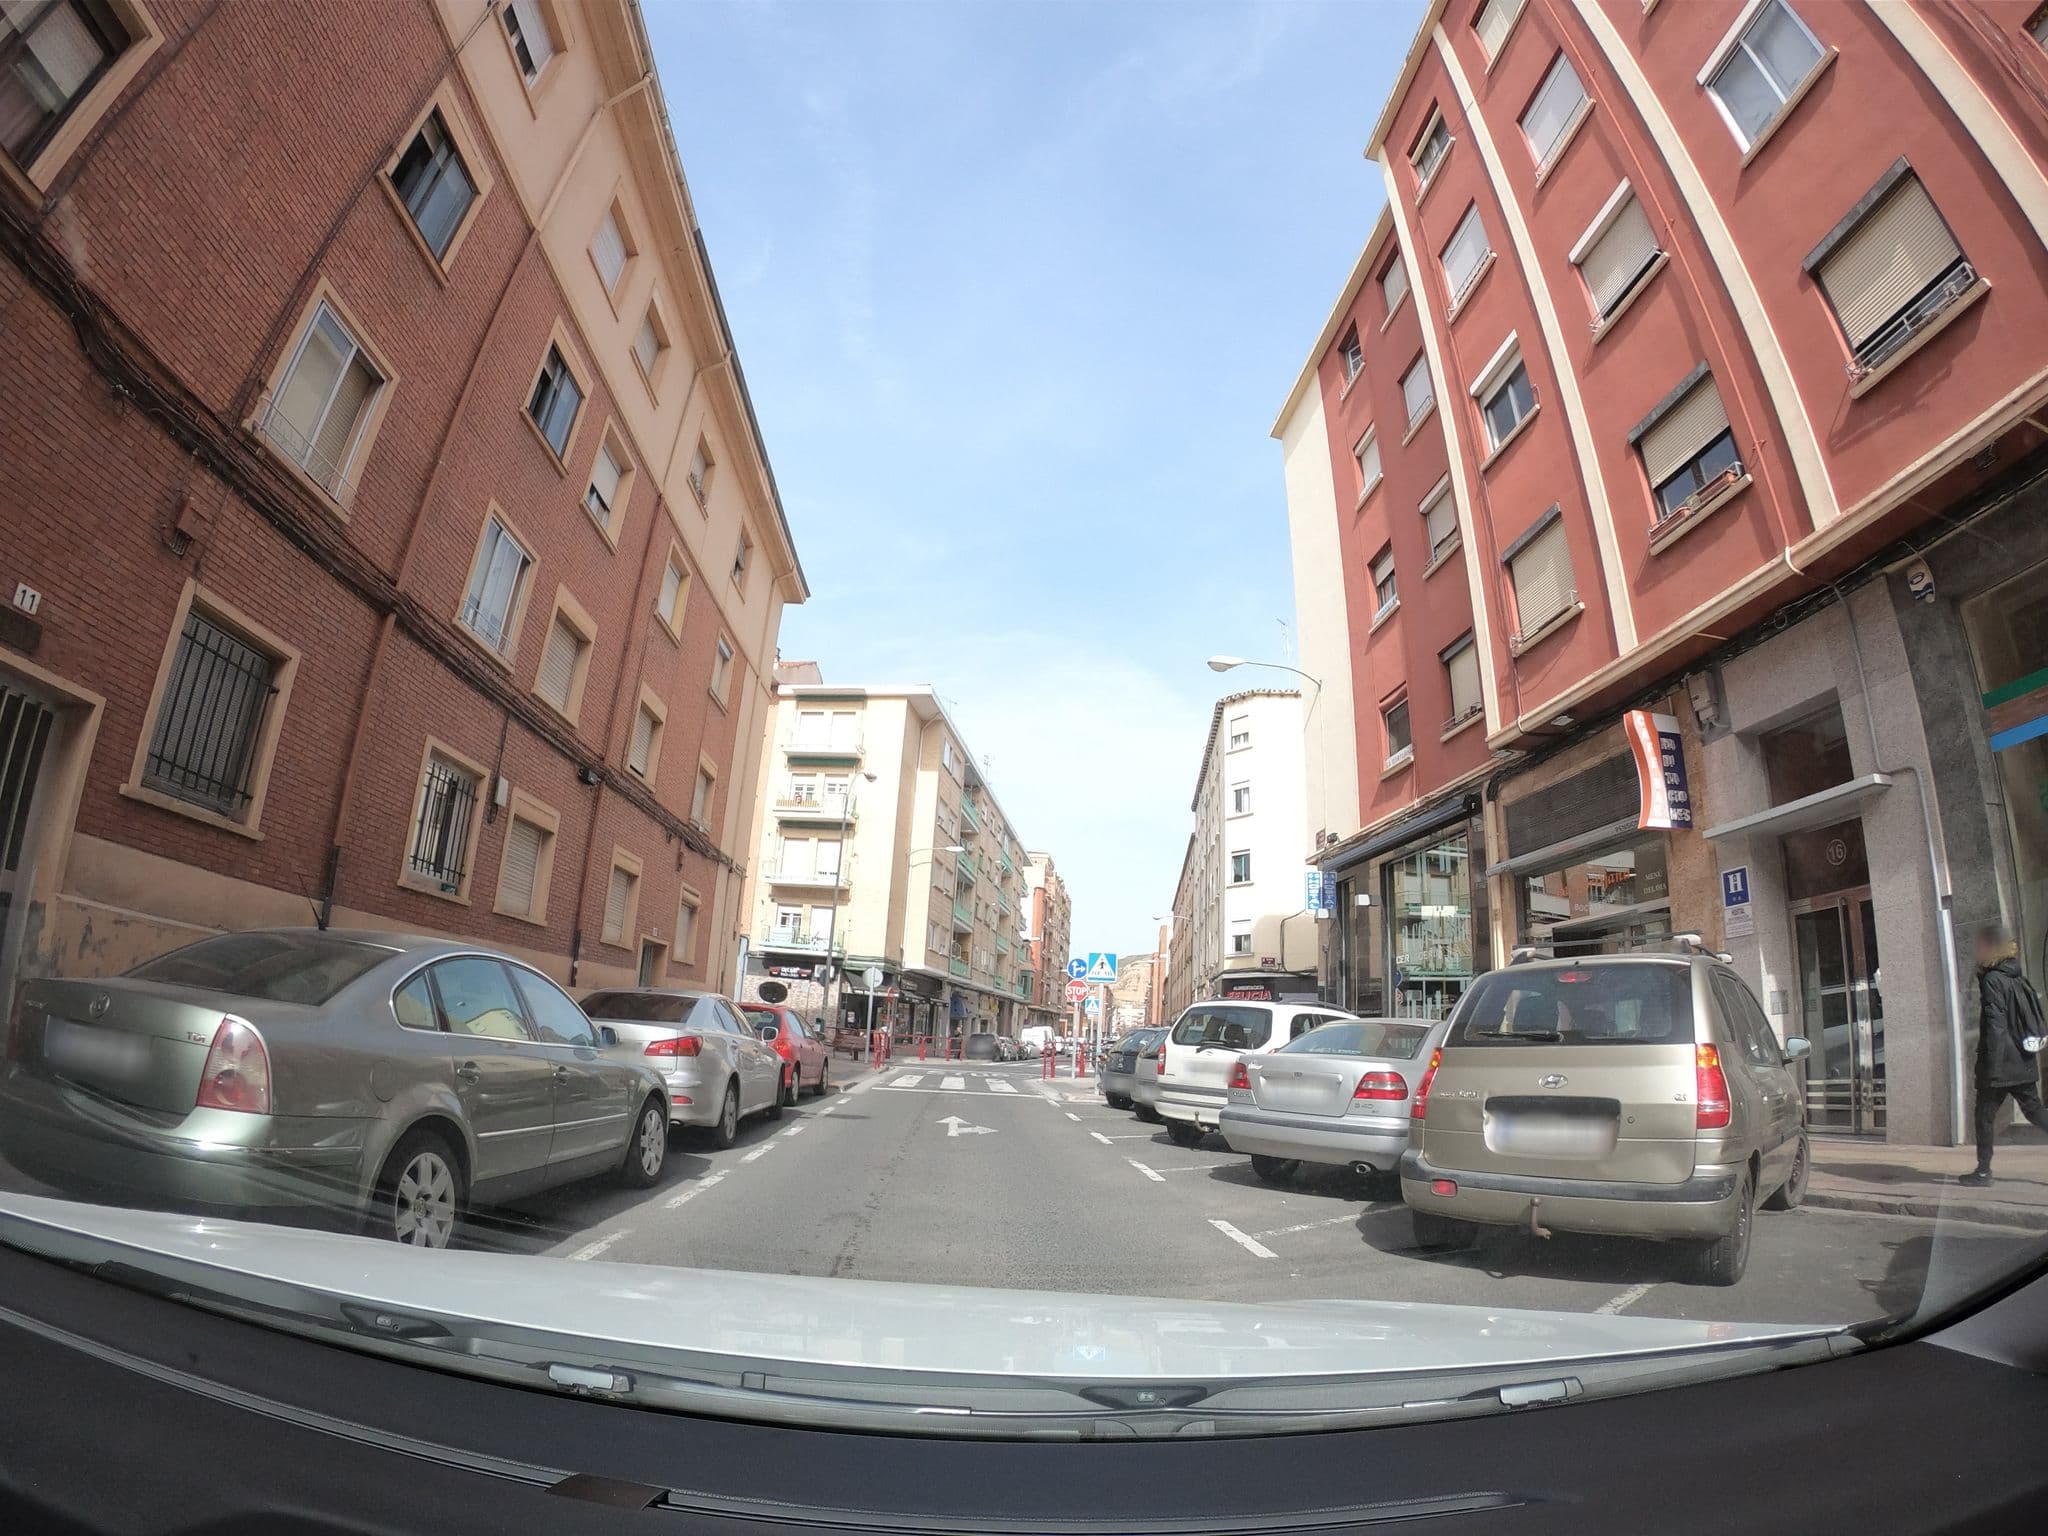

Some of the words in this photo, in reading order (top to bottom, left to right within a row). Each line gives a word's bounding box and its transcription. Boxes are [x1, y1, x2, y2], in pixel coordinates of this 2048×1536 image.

[21, 588, 37, 611] 11
[1829, 842, 1844, 860] 16
[1066, 986, 1087, 996] STOP
